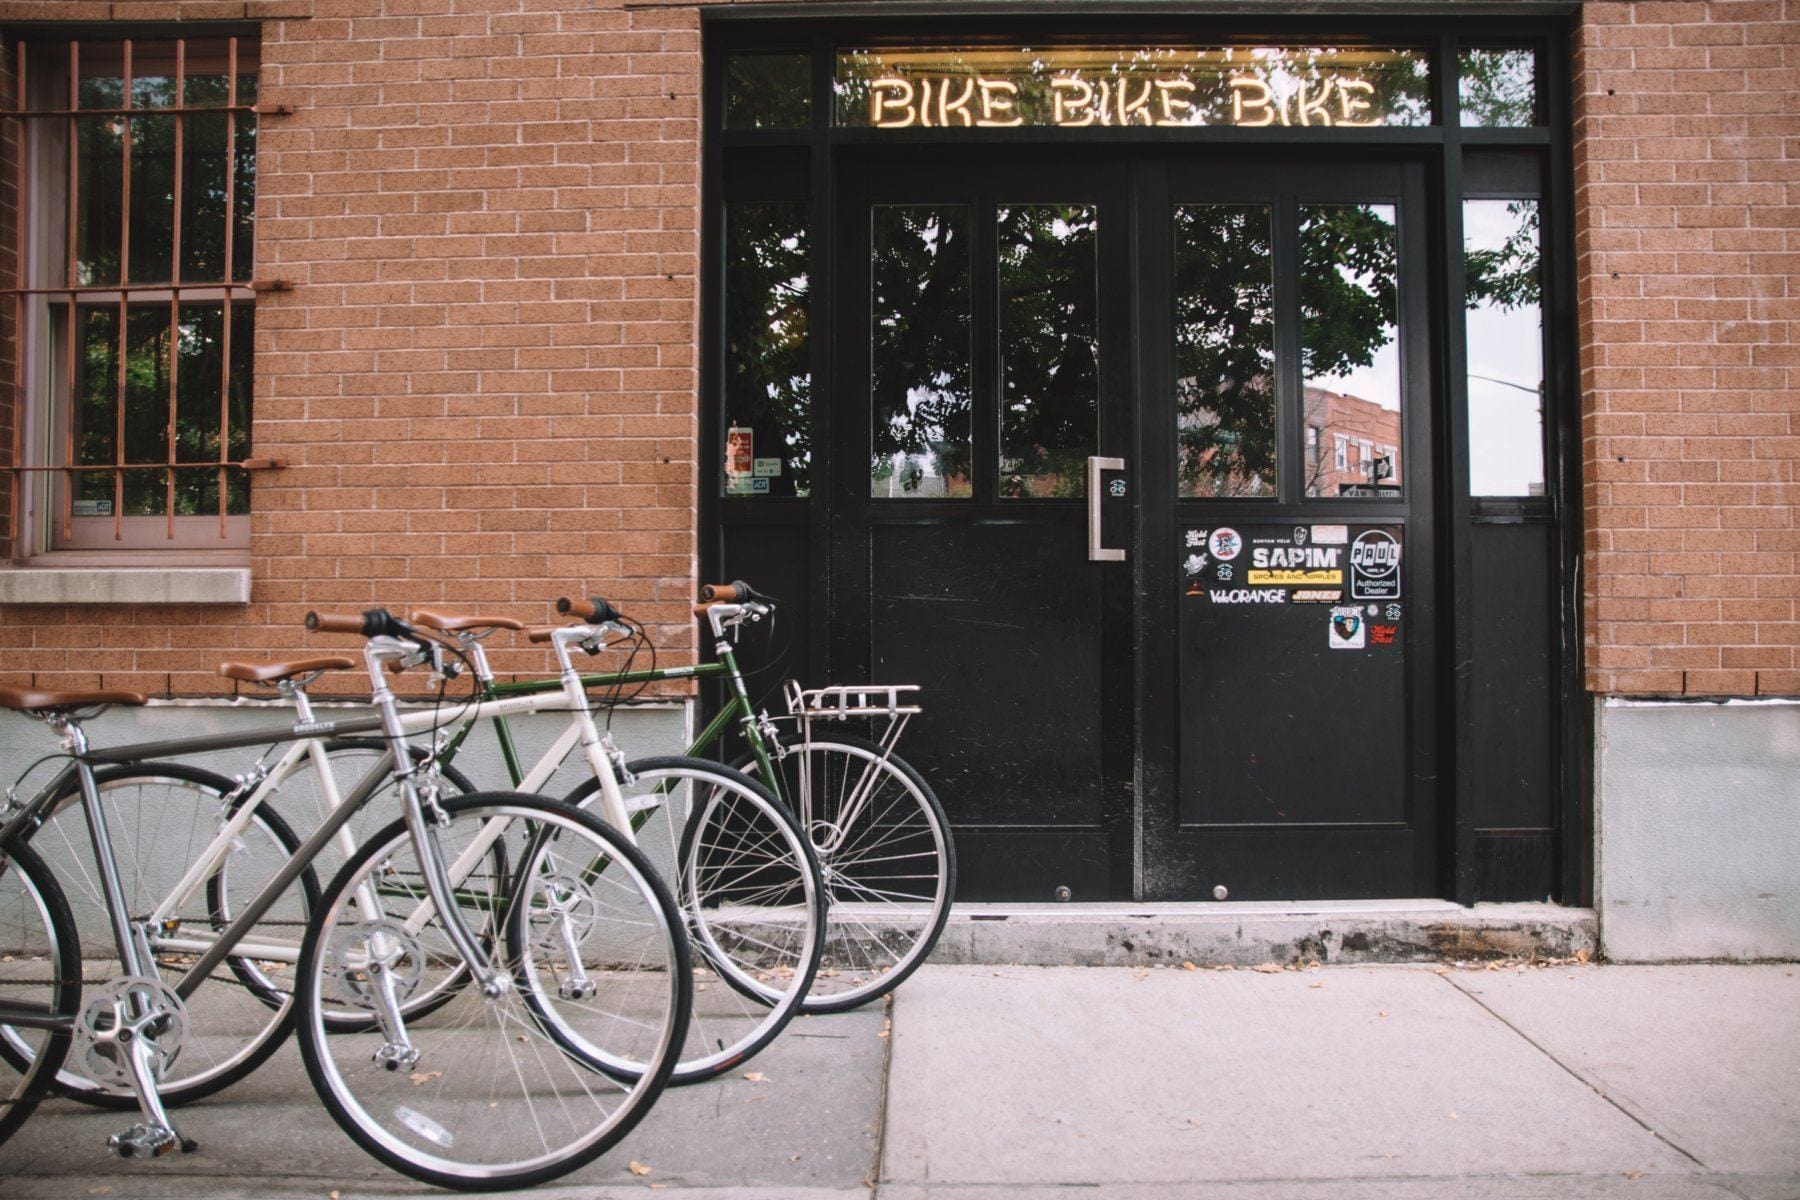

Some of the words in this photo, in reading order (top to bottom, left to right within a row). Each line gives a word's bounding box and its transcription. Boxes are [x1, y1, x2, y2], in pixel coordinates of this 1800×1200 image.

[872, 78, 1023, 127] BIKE
[1051, 78, 1202, 127] BIKE
[1230, 78, 1382, 127] BIKE
[1253, 548, 1337, 568] SAPIM
[1352, 545, 1398, 563] PAUL
[1292, 590, 1342, 600] JONES
[1371, 625, 1397, 634] Hold
[1371, 633, 1394, 644] Fast
